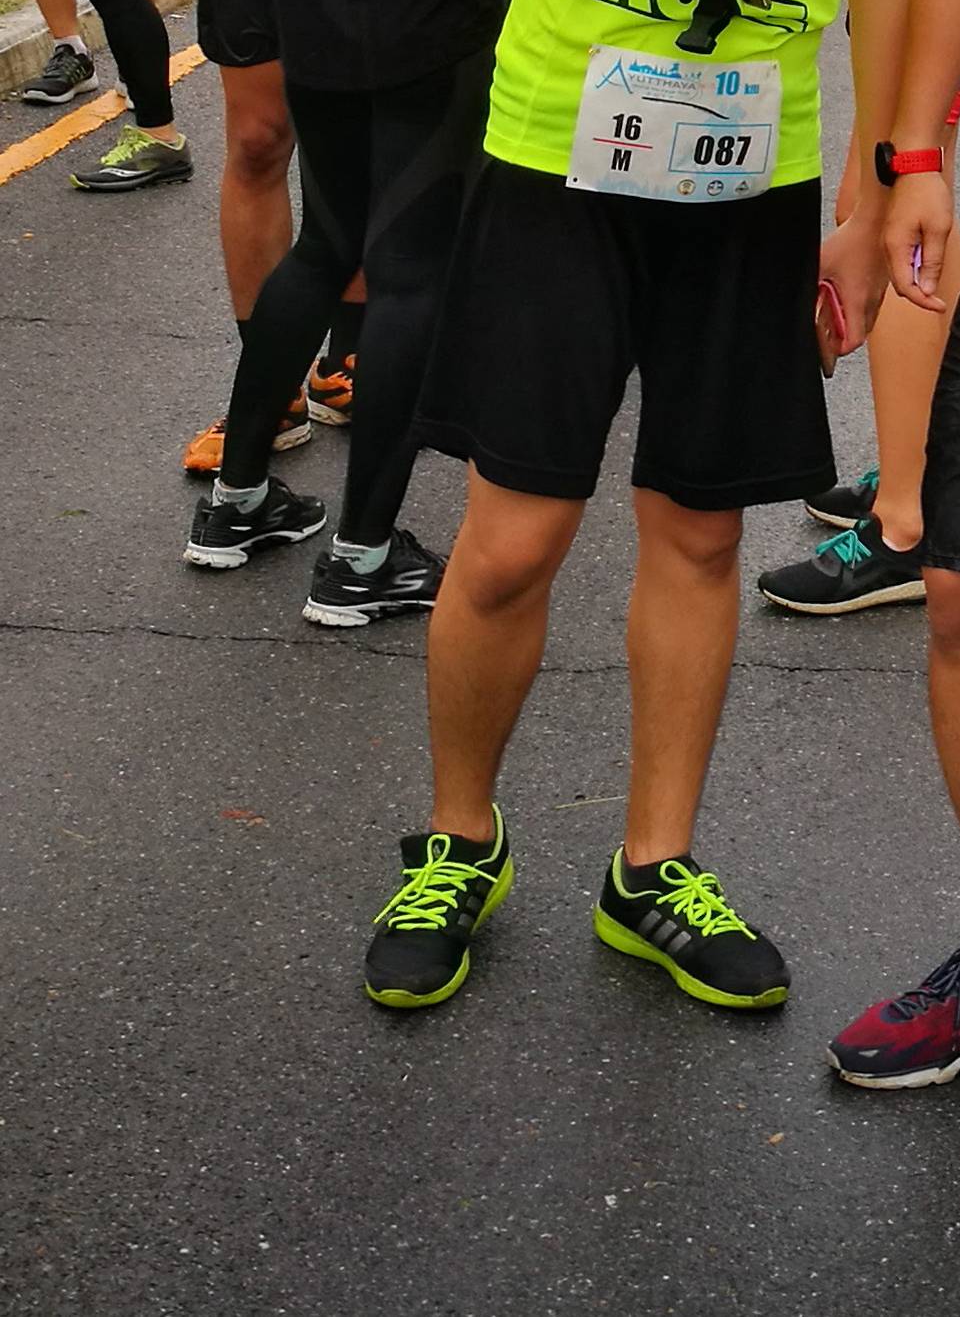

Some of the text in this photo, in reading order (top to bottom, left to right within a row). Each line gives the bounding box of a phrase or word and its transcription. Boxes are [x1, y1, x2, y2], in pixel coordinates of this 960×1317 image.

[596, 56, 697, 95] AYUTTHAYA
[716, 70, 760, 96] 10 km
[613, 113, 643, 140] 16
[611, 149, 633, 172] M
[693, 135, 752, 166] 087
